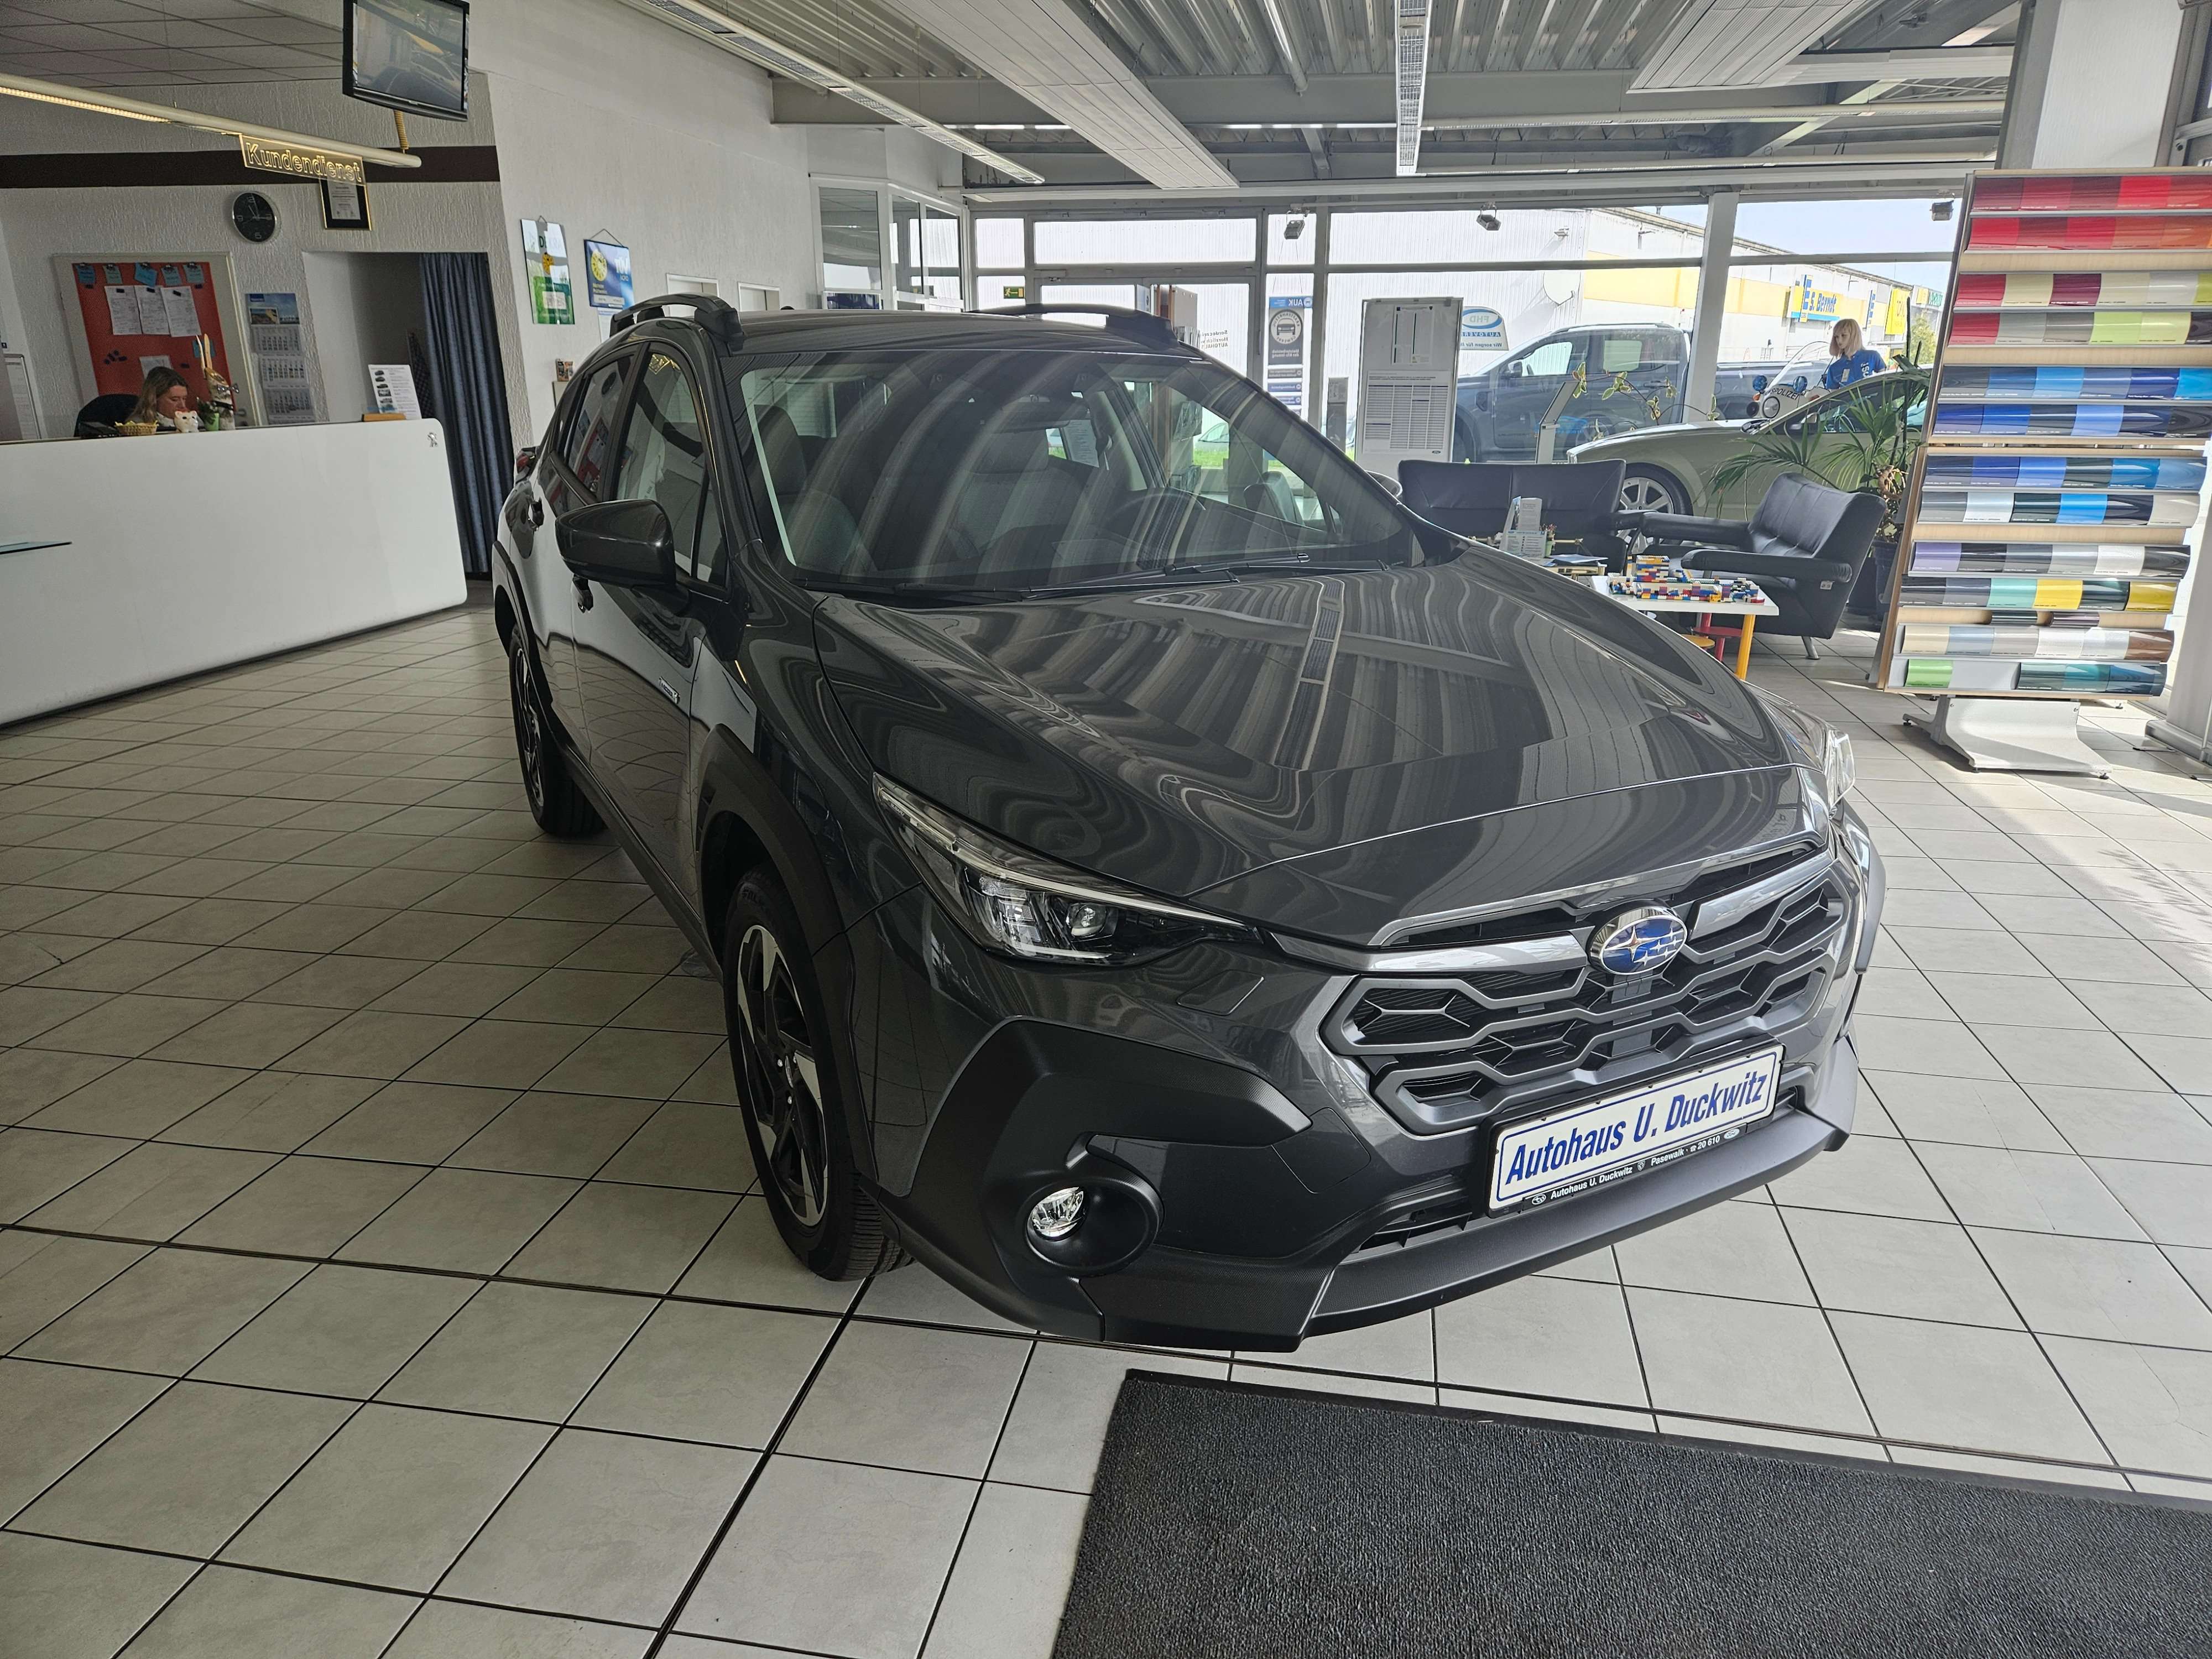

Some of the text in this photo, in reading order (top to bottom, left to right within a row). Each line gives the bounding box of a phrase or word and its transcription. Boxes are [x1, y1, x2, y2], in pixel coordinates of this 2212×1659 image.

[246, 142, 362, 182] Kundendienst
[1505, 1071, 1768, 1186] Autohaus U. Duckwitz
[1550, 1135, 1721, 1200] Autohaus U. Duckwitz Pasewalk 20 610
